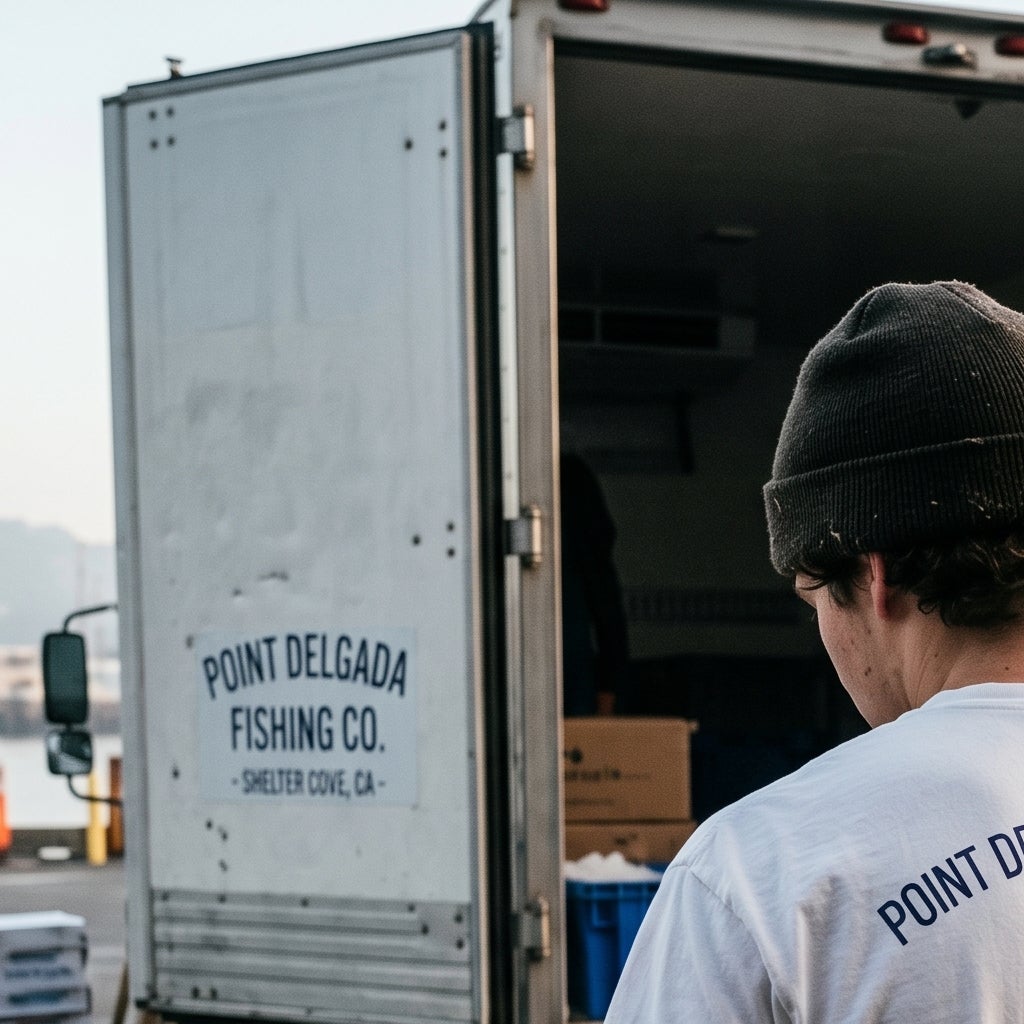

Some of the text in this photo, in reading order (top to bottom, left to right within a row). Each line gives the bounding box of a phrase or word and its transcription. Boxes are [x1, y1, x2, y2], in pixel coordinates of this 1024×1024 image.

[203, 632, 408, 701] POINT DELGADA
[230, 705, 386, 753] FISHING CO.
[242, 768, 304, 795] SHELTER
[308, 770, 351, 799] COVE,
[354, 769, 375, 795] CA
[876, 845, 990, 946] POINT
